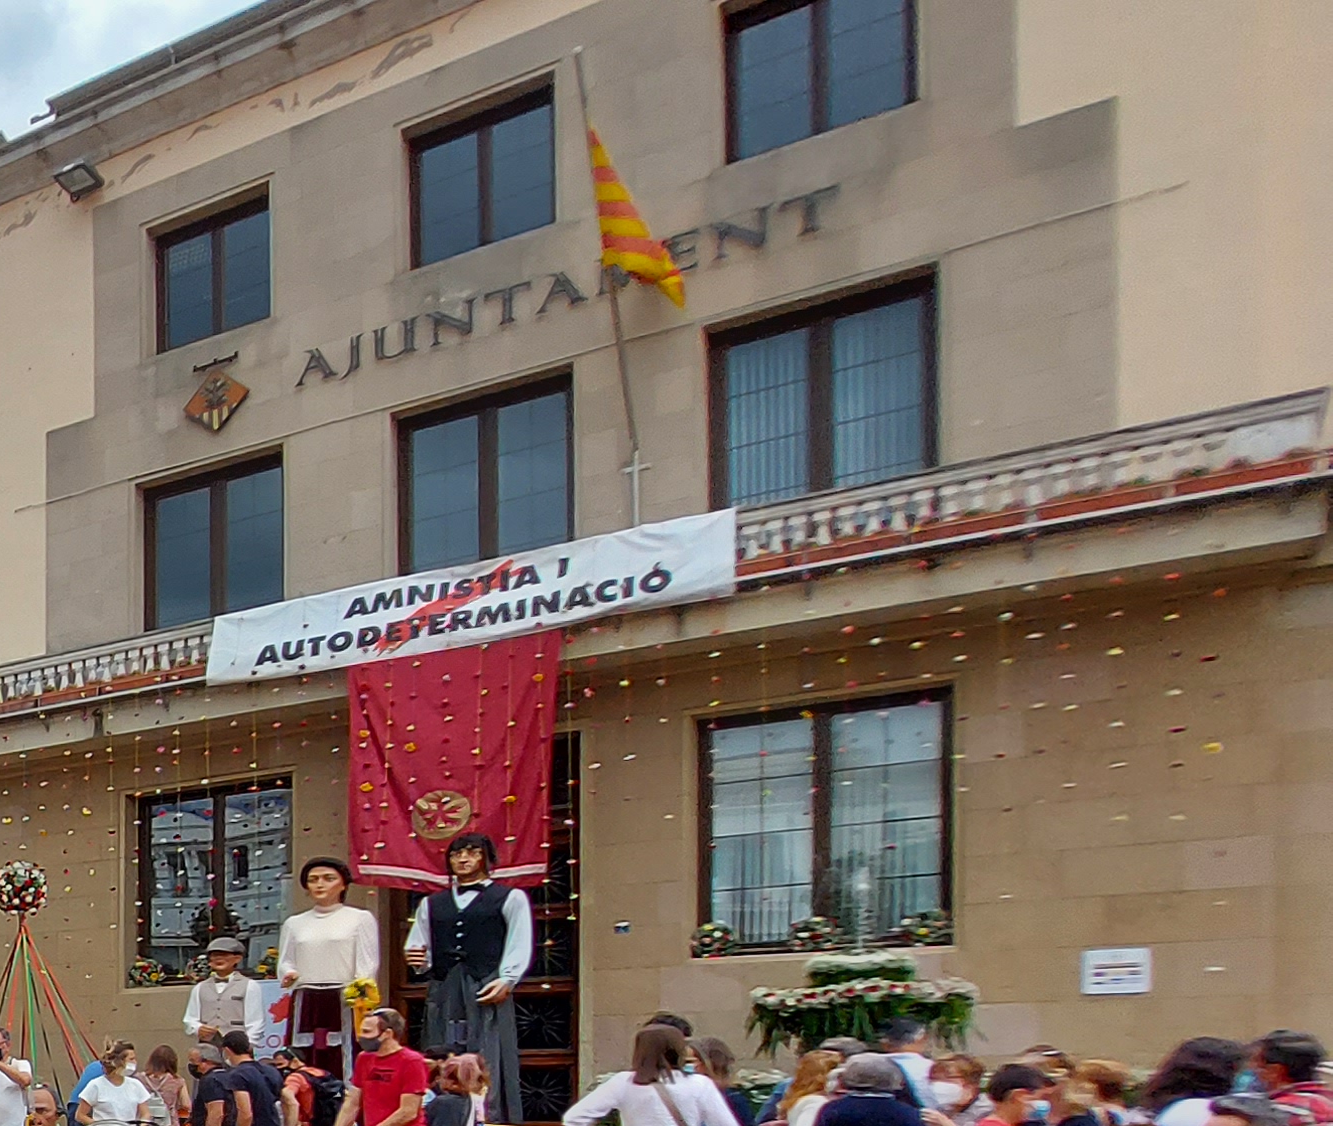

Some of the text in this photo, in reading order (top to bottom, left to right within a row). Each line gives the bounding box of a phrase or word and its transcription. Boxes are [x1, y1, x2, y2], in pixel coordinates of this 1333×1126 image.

[254, 561, 674, 667] AUTODETERMINACIÓ
[343, 558, 570, 620] AMNISTIA I
